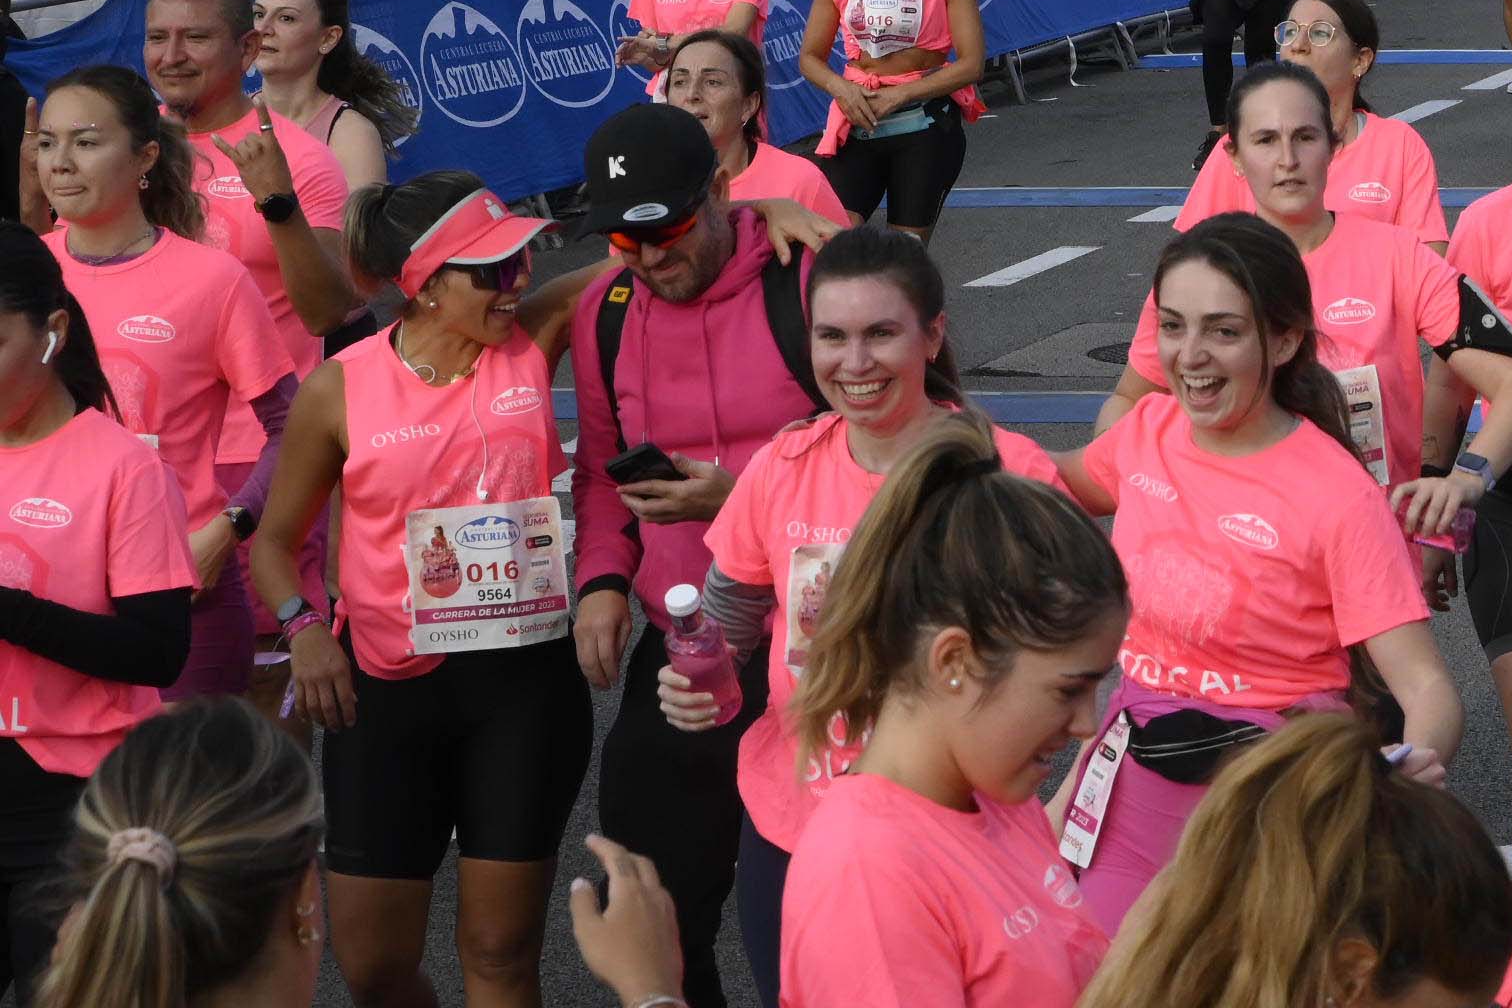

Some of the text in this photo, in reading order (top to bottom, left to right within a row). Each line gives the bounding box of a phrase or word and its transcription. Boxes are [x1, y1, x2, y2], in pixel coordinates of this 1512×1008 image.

[867, 16, 893, 26] 016
[526, 38, 610, 83] ASTURIANA
[430, 53, 522, 101] ASTURIANA
[121, 323, 173, 337] ASTURIANA
[1347, 385, 1370, 395] UMA
[494, 396, 542, 412] ASTURIANA
[372, 424, 441, 448] OYSHO
[13, 508, 69, 523] ASTURIANA
[523, 517, 549, 528] SUMA
[467, 560, 519, 583] 016
[478, 588, 511, 601] 9564
[432, 600, 555, 620] CARRERA DE LA MUJER 2023
[429, 629, 478, 642] OYSHO
[1110, 725, 1124, 738] UMA
